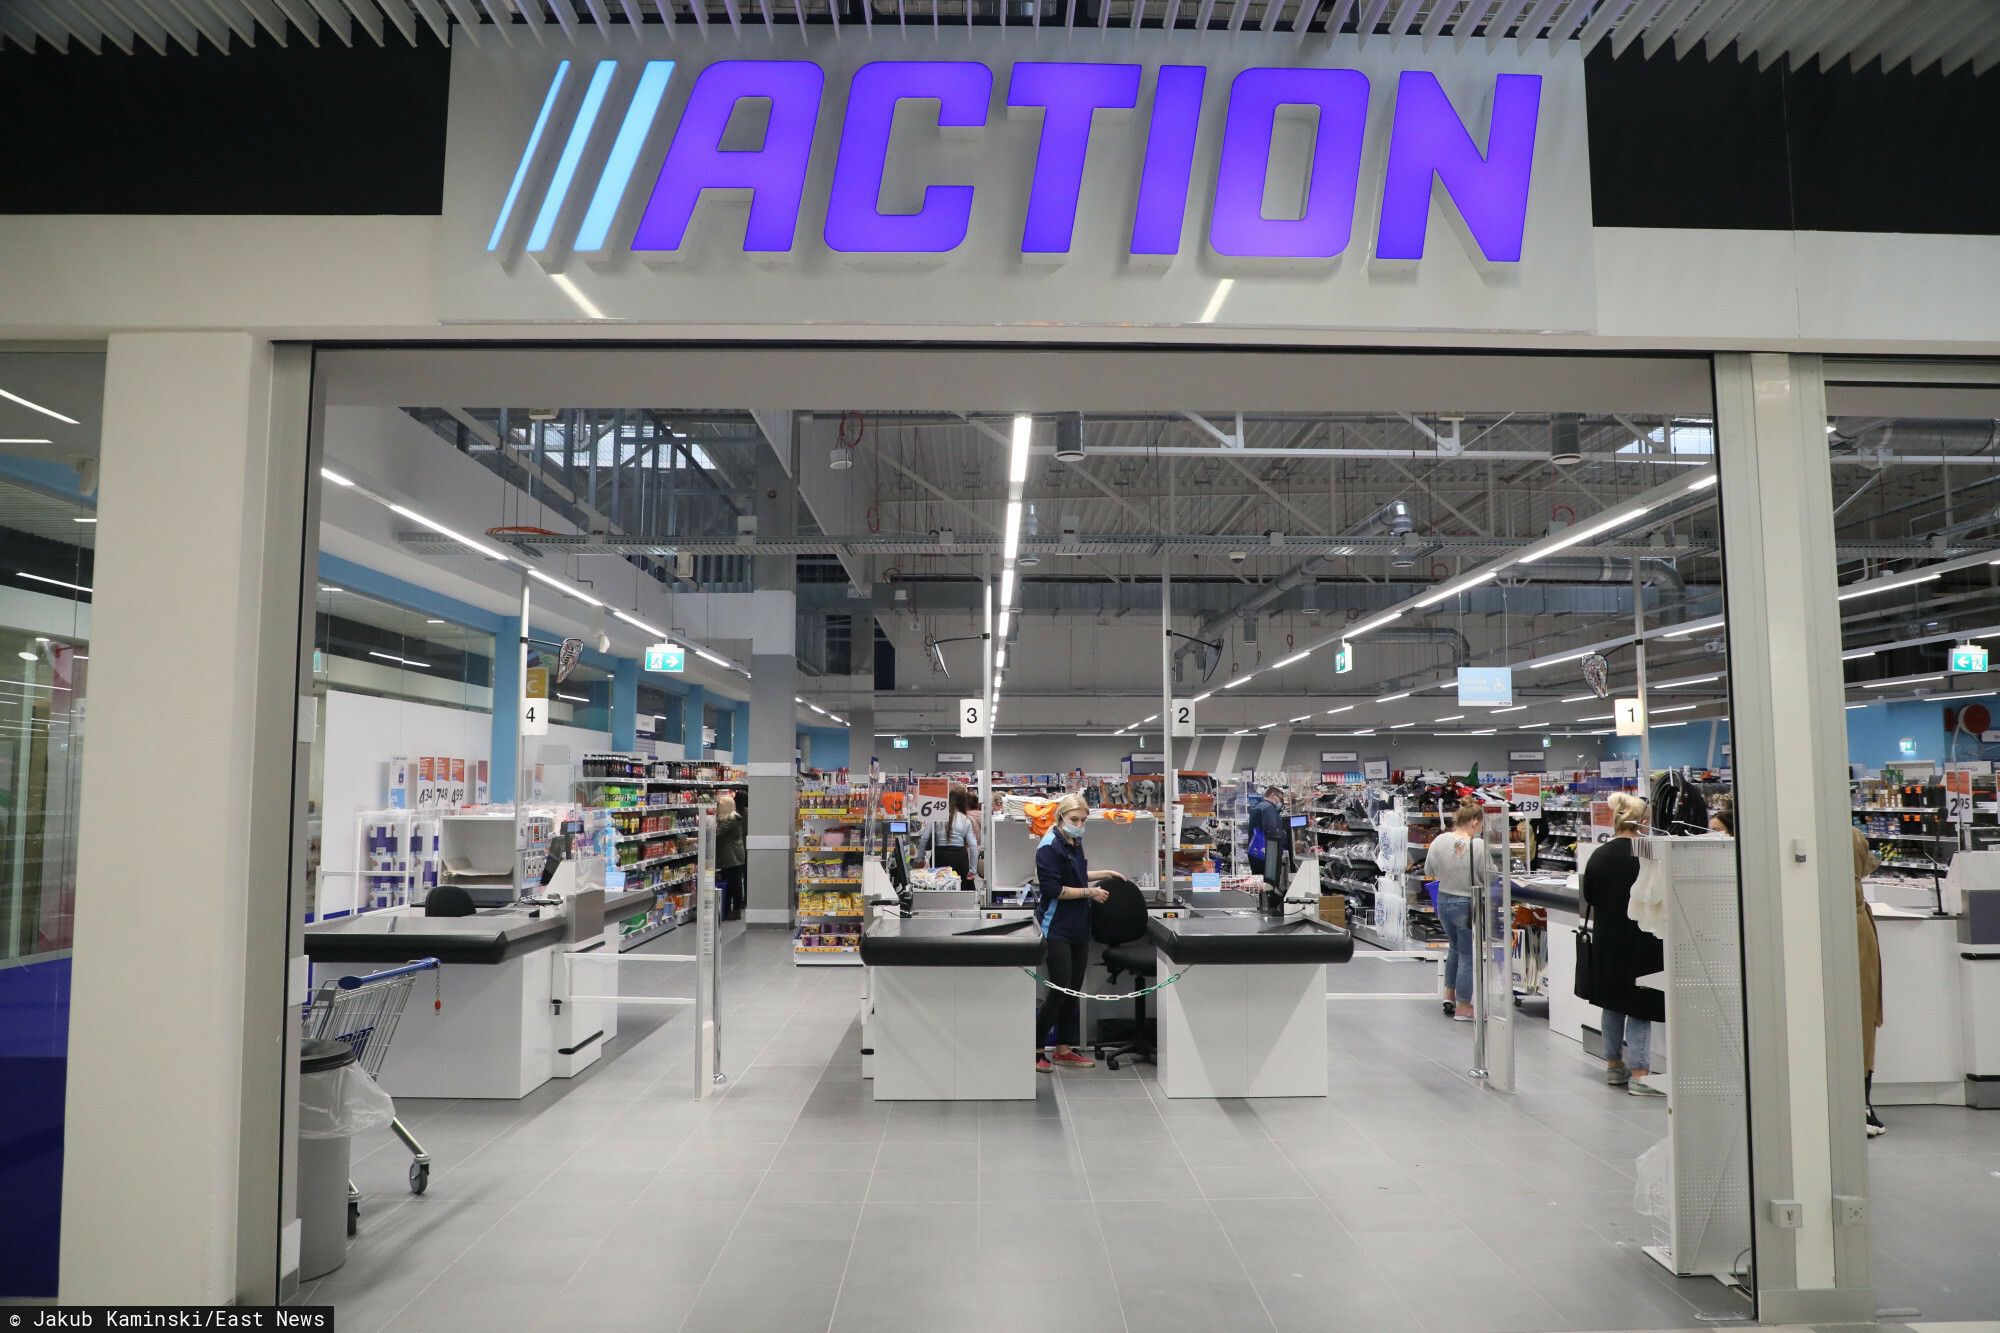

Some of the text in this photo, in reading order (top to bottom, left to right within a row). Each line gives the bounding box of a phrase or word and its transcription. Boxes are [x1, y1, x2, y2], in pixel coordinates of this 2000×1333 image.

[630, 59, 1543, 263] ACTION
[525, 706, 536, 723] 4
[966, 707, 978, 724] 3
[1178, 707, 1189, 724] 2
[1627, 707, 1635, 723] 1
